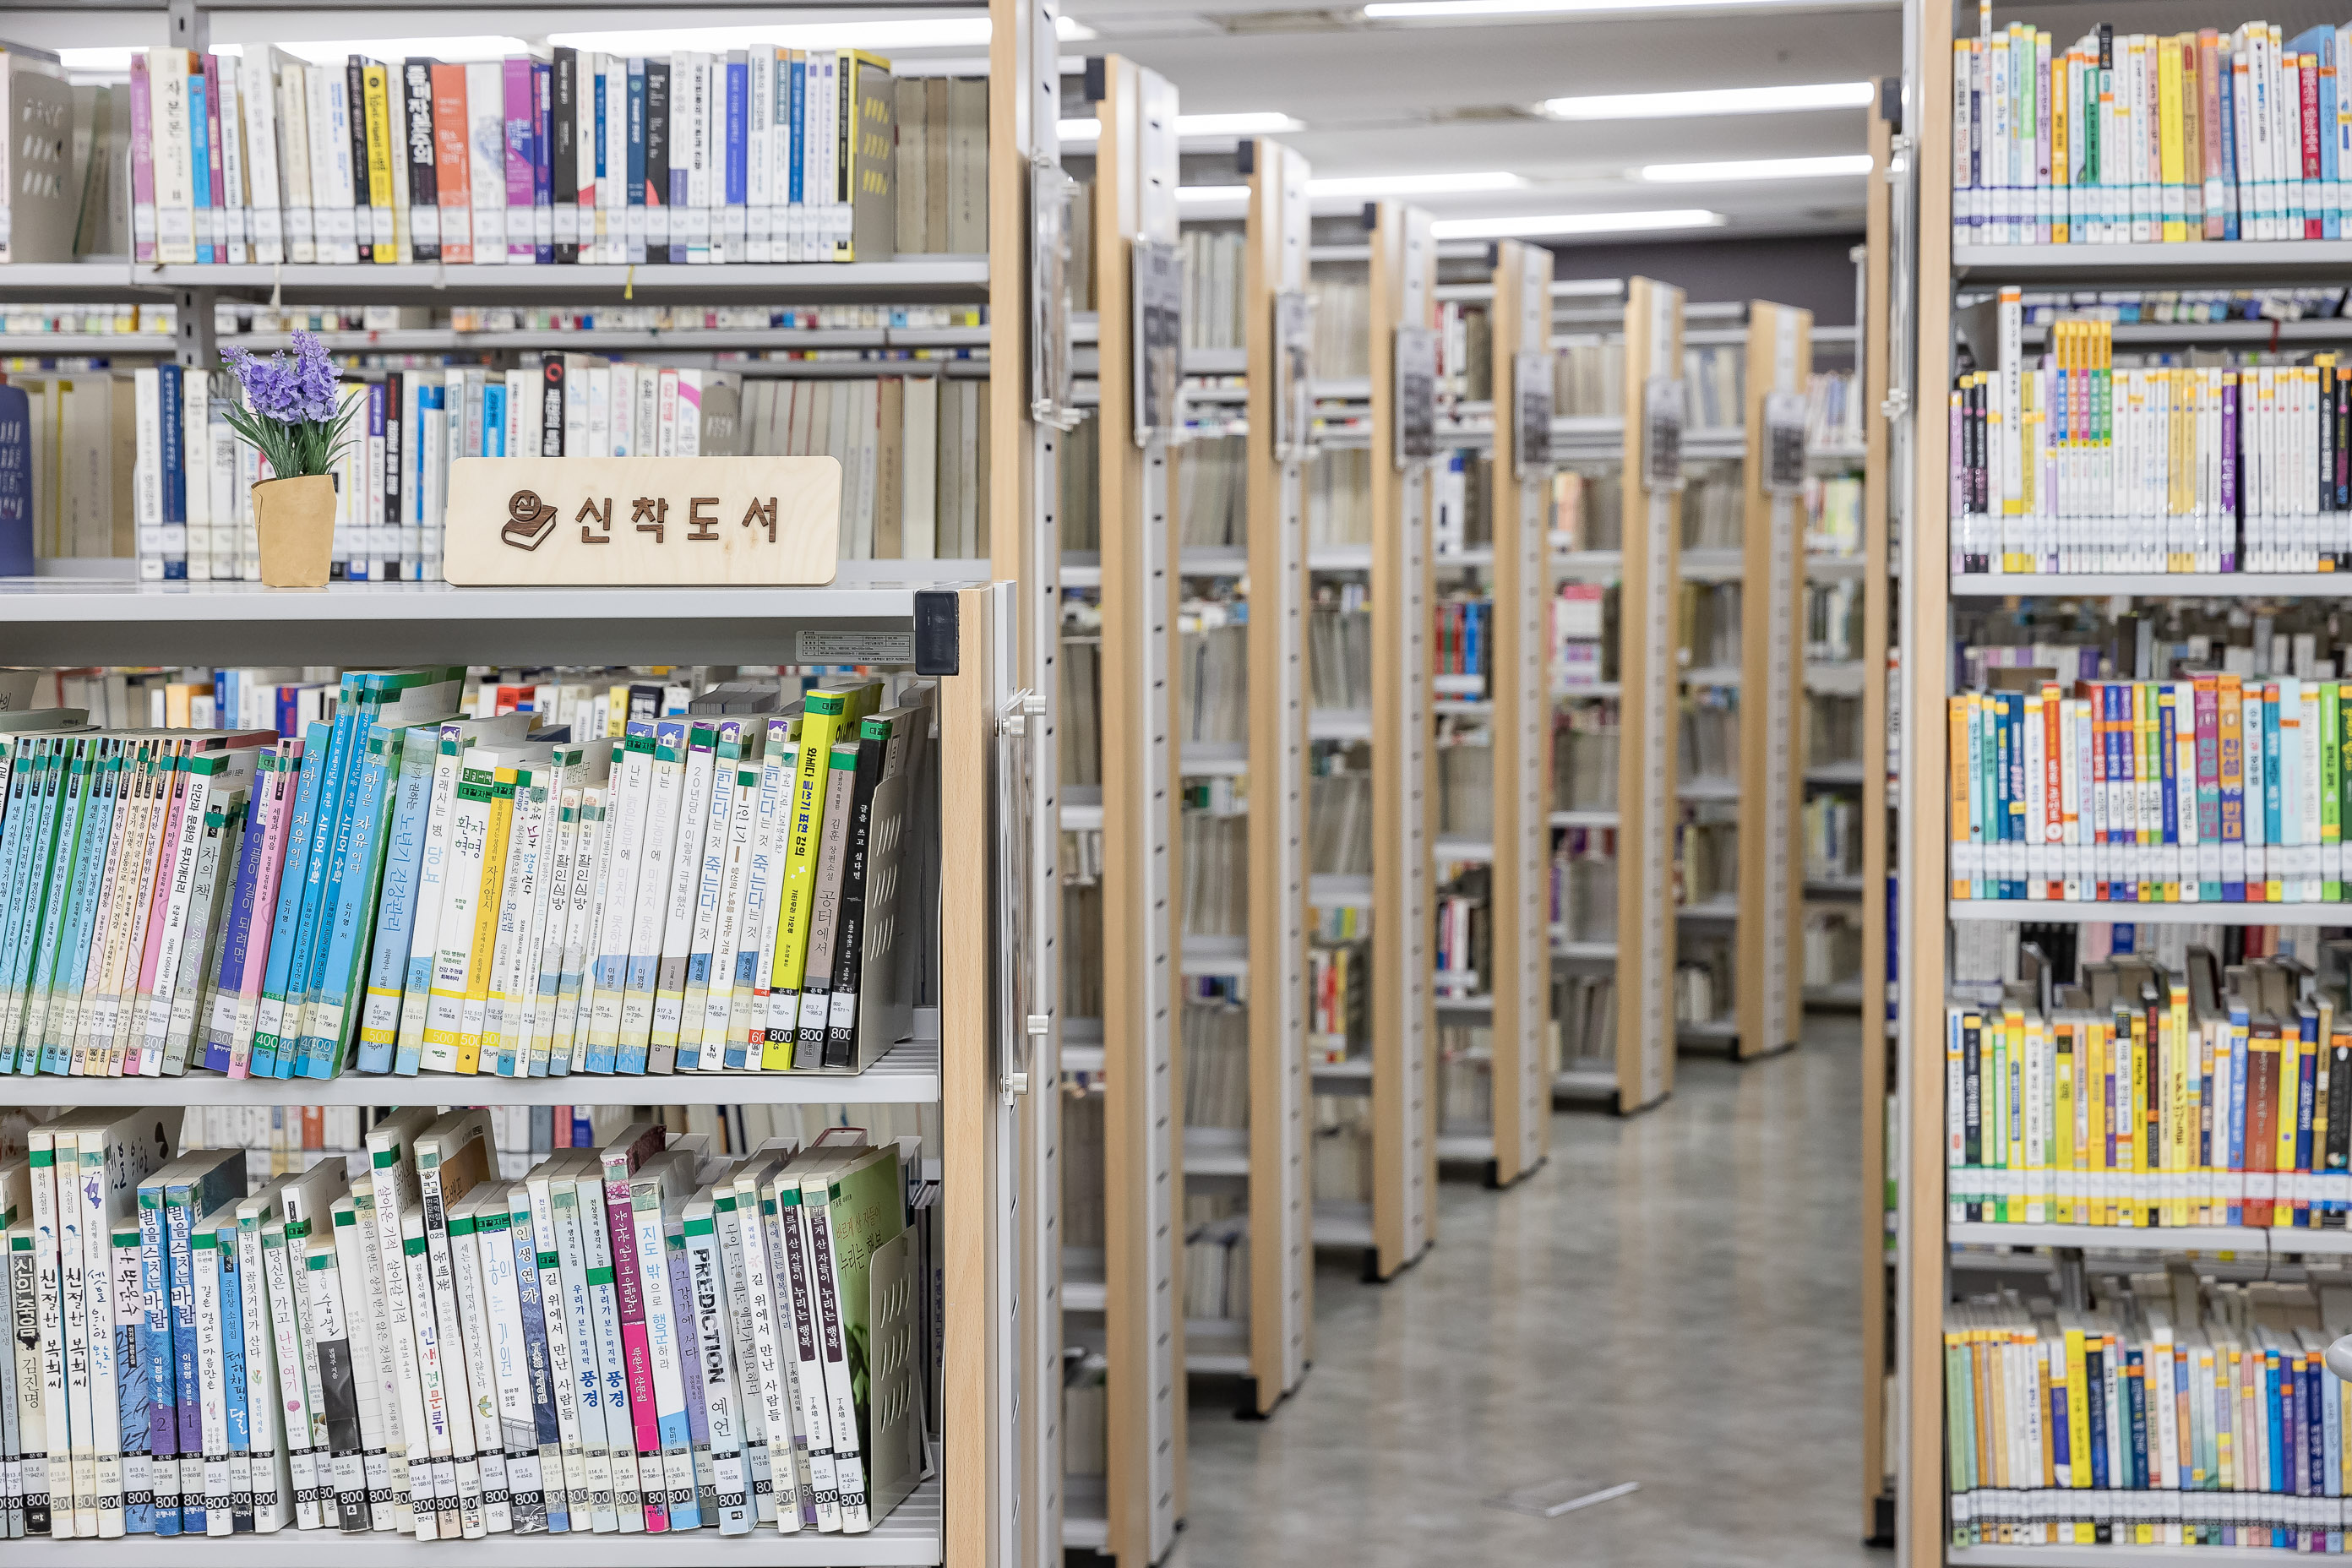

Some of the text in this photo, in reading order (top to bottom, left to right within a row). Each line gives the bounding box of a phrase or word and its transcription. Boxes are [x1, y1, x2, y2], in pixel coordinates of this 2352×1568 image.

[574, 496, 778, 543] 신착도서
[464, 768, 493, 783] 큰글자책
[462, 787, 493, 799] 대활자본
[794, 747, 817, 857] 와세다 글쓰기 표현 강의
[41, 804, 52, 836] 아름다운
[63, 805, 74, 837] 아름다운
[167, 805, 181, 847] 세월과 마음
[269, 808, 281, 850] 세월과 마음
[456, 815, 486, 836] 환자
[732, 803, 749, 843] 1인 1기
[175, 783, 203, 894] 인간과 문화의 무지개다리
[455, 836, 481, 859] 혁명
[826, 819, 841, 881] 김훈 장편소설
[853, 804, 868, 879] 글을 쓰고 싶다면
[248, 832, 264, 879] 아픔이
[194, 846, 219, 901] 차의 책
[729, 867, 739, 889] 당신의
[482, 865, 498, 912] 자기암시
[193, 907, 205, 927] The
[722, 915, 733, 937] 바꾸는
[814, 890, 836, 957] 공터에서
[189, 928, 202, 953] Book
[720, 939, 730, 956] 기적
[185, 965, 197, 983] Tea
[256, 1033, 278, 1048] 400
[770, 1030, 792, 1043] 800
[799, 1029, 824, 1042] 800
[831, 1028, 852, 1041] 800
[477, 1217, 510, 1228] 대활자본
[167, 1206, 195, 1325] 별을 스치는 바람
[291, 1240, 304, 1264] 남아
[378, 1186, 407, 1323] 살아온 기적 살아갈 기적
[615, 1210, 638, 1315] 못 가본 길이 더 아름답다
[139, 1209, 167, 1330] 별을 스치는 바람
[296, 1268, 308, 1293] 있는
[433, 1251, 450, 1291] 동백꽃
[676, 1271, 688, 1280] 그
[783, 1206, 812, 1348] 바르게 산 자들이 누리는 행복
[812, 1206, 839, 1348] 바르게 산 자들이 누리는 행복
[15, 1258, 37, 1337] 신의 죽음
[243, 1232, 261, 1358] 뒤뜰에 골칫거리가 산다
[370, 1277, 382, 1295] 상처
[642, 1226, 670, 1370] 지도 밖으로 행군하라
[269, 1250, 297, 1392] 당신은 가고 나는 여기
[300, 1297, 313, 1334] 시간을
[373, 1298, 384, 1318] 받지
[678, 1287, 694, 1326] 강가에
[693, 1248, 726, 1385] PREDICTION
[40, 1268, 62, 1389] 친절한 복희씨
[65, 1267, 87, 1388] 친절한 복희씨
[226, 1311, 237, 1340] 소설집
[545, 1272, 574, 1420] 길 위에서 만난 사람들
[573, 1284, 598, 1407] 우리가 보는 마지막 풍경
[599, 1284, 624, 1408] 우리가 보는 마지막 풍경
[684, 1334, 699, 1360] 서다
[751, 1273, 781, 1421] 길 위에서 만난 사람들
[154, 1357, 162, 1383] 이정명
[182, 1353, 192, 1379] 이정명
[475, 1362, 487, 1388] 않는다
[631, 1347, 648, 1402] 박완서 산문집
[21, 1357, 40, 1408] 김진명
[156, 1417, 166, 1432] 2
[187, 1413, 193, 1428] 1
[711, 1396, 732, 1437] 예언
[26, 1494, 50, 1506] 800
[100, 1495, 122, 1509] 800
[128, 1492, 151, 1504] 800
[155, 1495, 178, 1508] 800
[340, 1490, 364, 1504] 800
[369, 1489, 392, 1502] 800
[485, 1489, 509, 1502] 800
[514, 1491, 539, 1505] 800
[719, 1493, 743, 1506] 800
[815, 1489, 838, 1504] 800
[841, 1493, 864, 1506] 800
